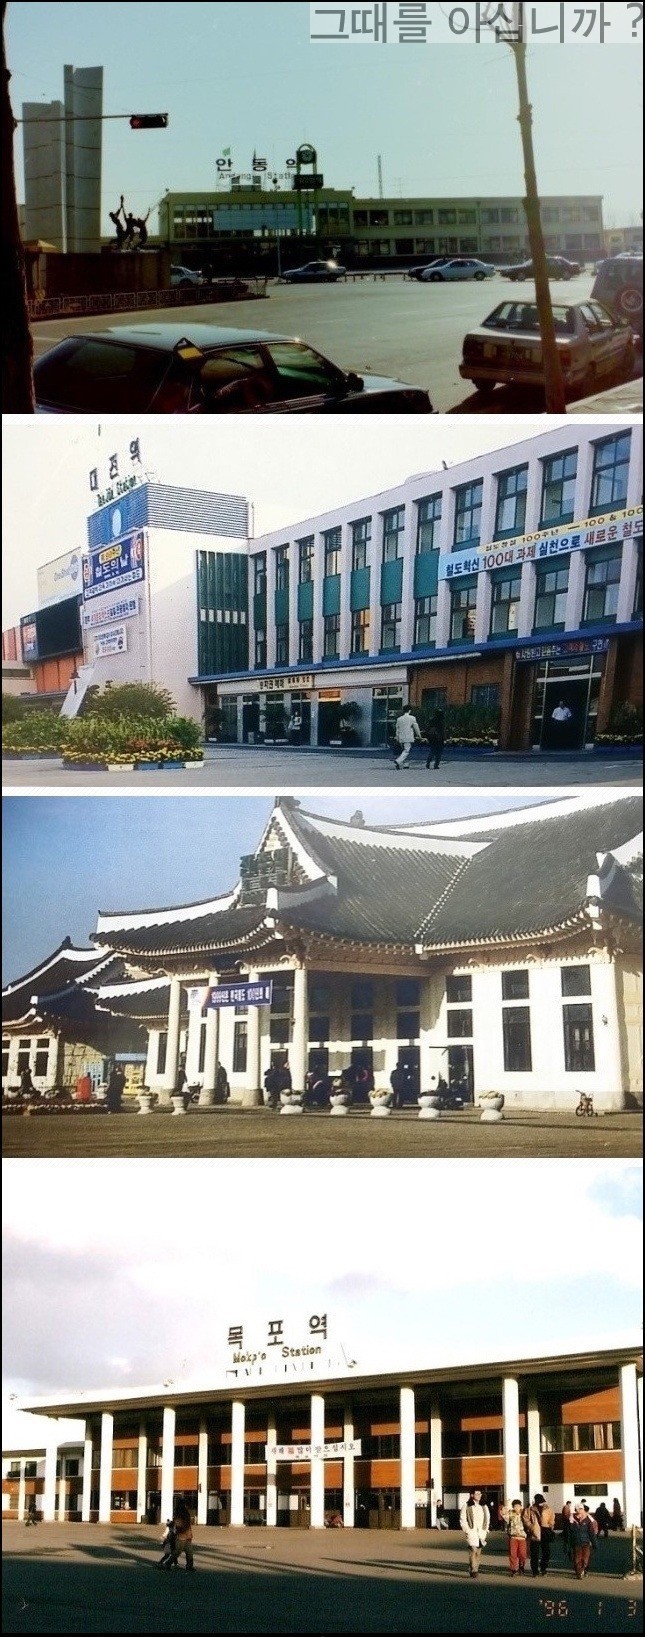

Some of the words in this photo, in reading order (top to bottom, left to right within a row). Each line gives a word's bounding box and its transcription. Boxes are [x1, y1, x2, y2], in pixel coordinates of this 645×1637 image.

[584, 517, 605, 528] 100
[446, 557, 480, 577] 철도혁신
[482, 550, 514, 569] 100대
[515, 543, 537, 561] 과제
[538, 534, 581, 556] 실천으로
[584, 525, 618, 546] 새로운
[227, 1313, 327, 1349] 목포역
[282, 1345, 322, 1358] Station
